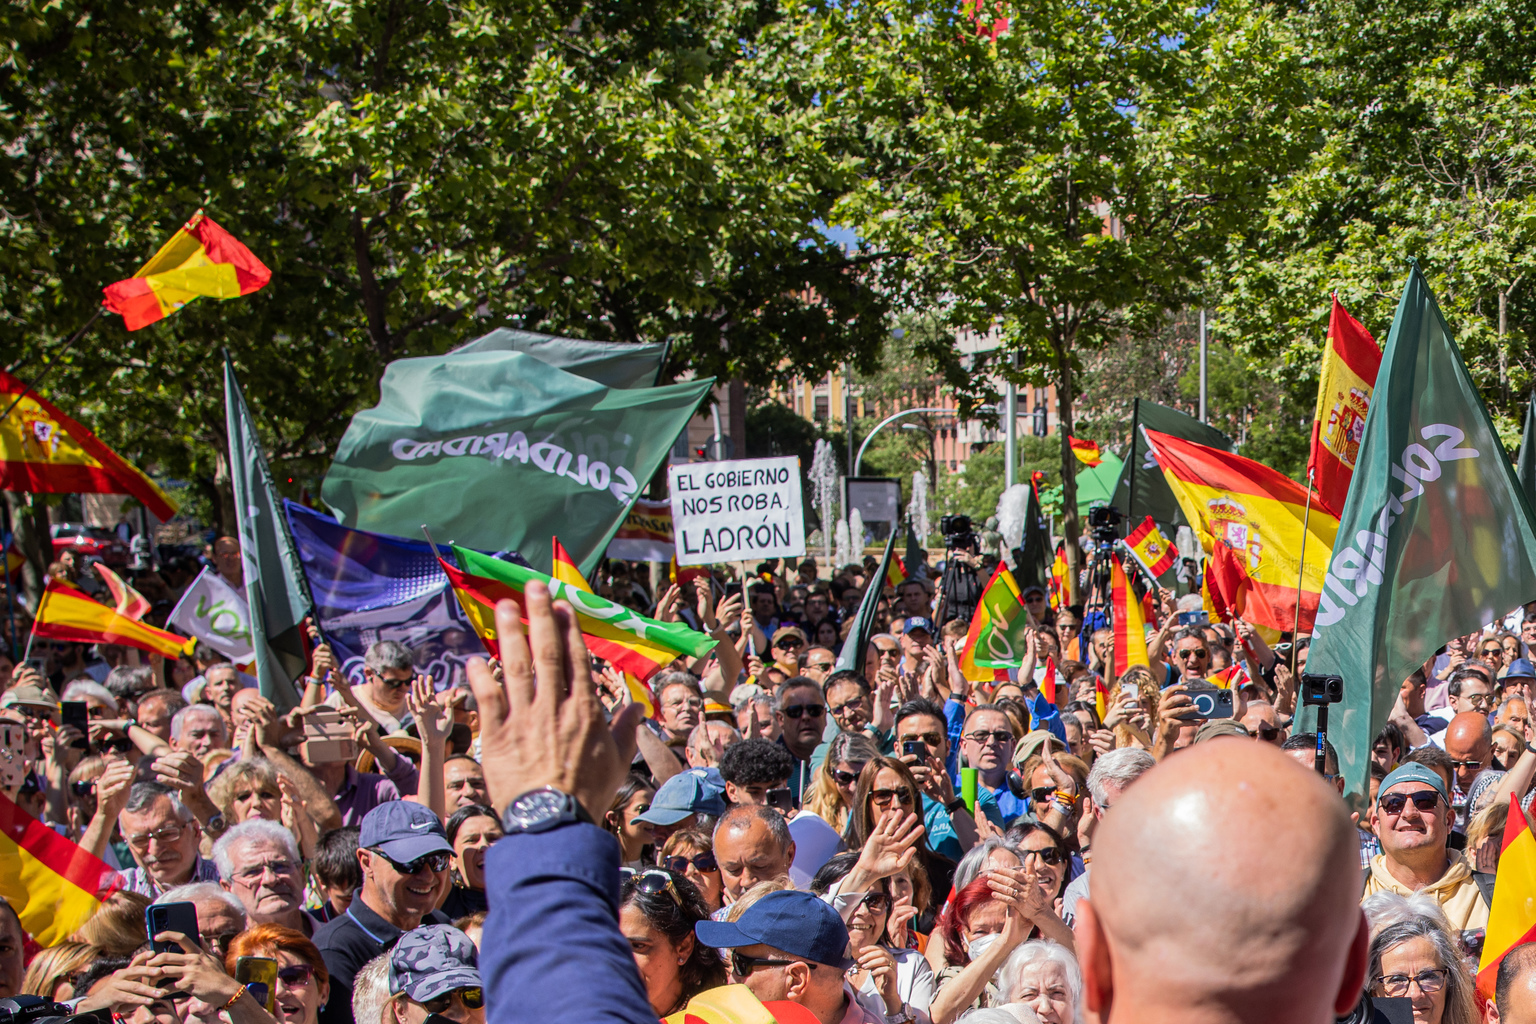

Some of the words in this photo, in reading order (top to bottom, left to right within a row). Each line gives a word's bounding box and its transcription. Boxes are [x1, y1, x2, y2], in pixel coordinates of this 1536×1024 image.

[677, 473, 700, 492] EL
[682, 496, 722, 516] NOS
[682, 515, 790, 554] LADRÓN
